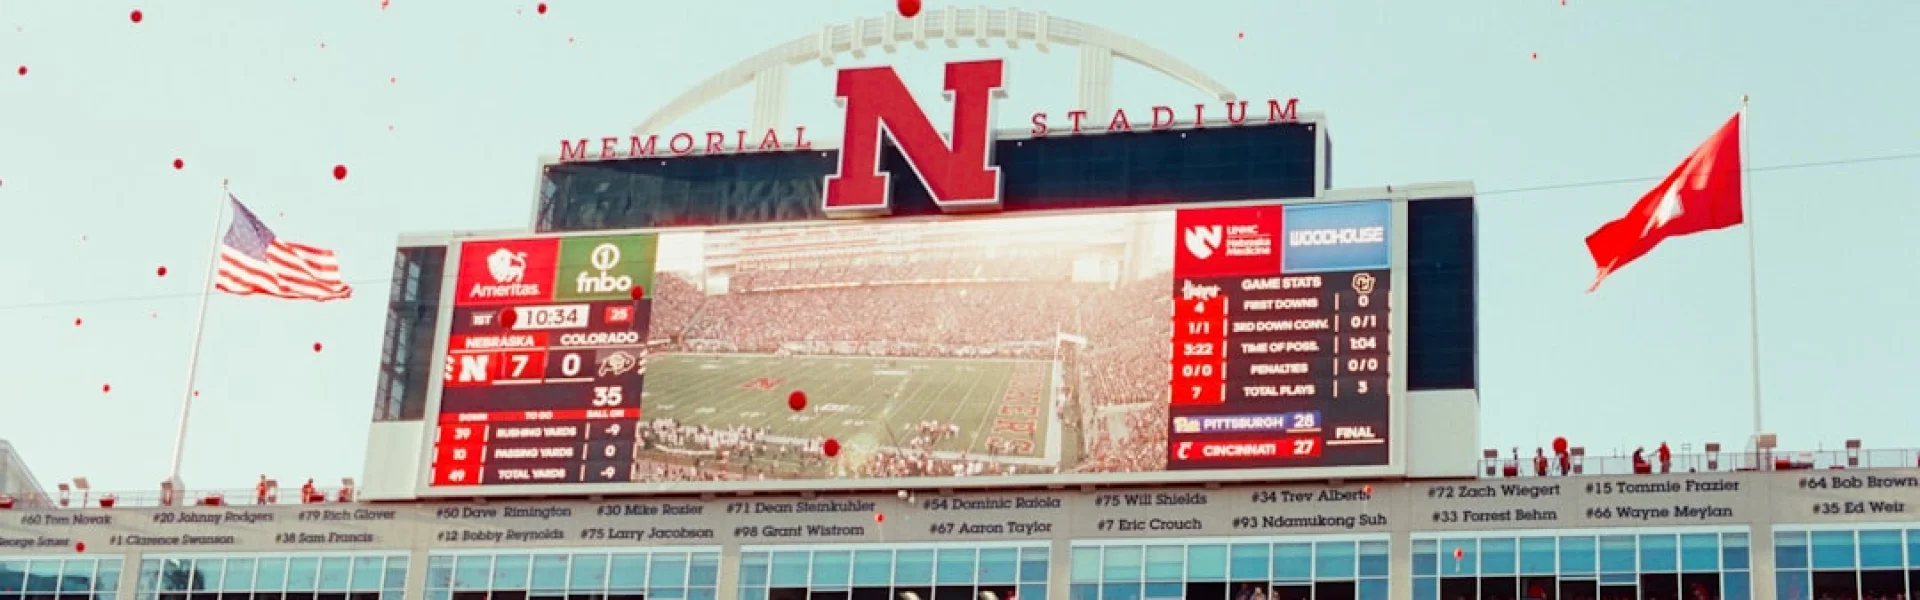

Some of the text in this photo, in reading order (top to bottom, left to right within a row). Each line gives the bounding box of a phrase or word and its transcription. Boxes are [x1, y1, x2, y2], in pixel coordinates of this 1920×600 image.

[560, 98, 1300, 161] MEMORIAL STADIUM
[823, 58, 1003, 212] N
[1289, 226, 1384, 246] WOODHOUSE
[576, 271, 632, 293] fnbo
[1241, 276, 1322, 290] GAME STATS
[1275, 298, 1318, 309] DOWNS
[1358, 296, 1369, 307] 0
[526, 309, 578, 326] 10:34
[1256, 321, 1293, 331] DOWN
[465, 335, 534, 348] NEBRASKA
[560, 331, 639, 345] COLORADO
[1270, 342, 1285, 352] OF
[458, 353, 581, 382] N 7 0
[1251, 363, 1309, 375] PENALTIES
[592, 386, 623, 406] 35
[1192, 381, 1367, 399] 7 TOTAL PLAYS 3
[1203, 417, 1284, 430] PITTSBURGH
[1294, 413, 1315, 427] 28
[1336, 426, 1375, 438] FINAL
[453, 449, 467, 460] 10
[604, 445, 616, 457] 0
[1202, 444, 1276, 457] CINCINNATI
[1294, 440, 1313, 455] 27
[498, 469, 531, 479] TOTAL
[532, 468, 566, 479] YARDS
[1586, 479, 1740, 494] #15 Tommie Frazier
[1799, 475, 1918, 489] #64 Bob Brown
[1252, 491, 1277, 503] #34
[1281, 491, 1313, 502] Trev
[1428, 484, 1561, 499] #72 Zach Wiegert
[923, 496, 1061, 511] #54 Dominic Raiola
[1095, 493, 1207, 506] #75 Will Shields
[436, 505, 572, 520] #50 Dave Rimington
[597, 504, 705, 516] #30 Mike Rozier
[726, 500, 876, 514] #71 Dean Steinkuhler
[1586, 505, 1733, 521] #66 Wayne Meylan
[1812, 501, 1904, 515] #35 Ed Weir
[72, 513, 112, 525] Novak
[153, 511, 274, 525] #20 Johnny Rodgers
[298, 508, 396, 521] #79 Rich Glover
[1232, 513, 1387, 530] #93 Ndamukong Suh
[1432, 508, 1558, 522] #33 Forrest Behm
[733, 524, 864, 538] #98 Grant Wistrom
[929, 520, 1053, 535] #67 Aaron Taylor
[1097, 518, 1202, 531] #7 Eric Crouch
[126, 534, 179, 545] Clarence
[182, 534, 234, 545] Swanson
[275, 532, 373, 544] #38 Sam Francis
[437, 528, 564, 543] #12 Bobby Reynolds
[580, 526, 714, 541] #75 Larry Jacobson
